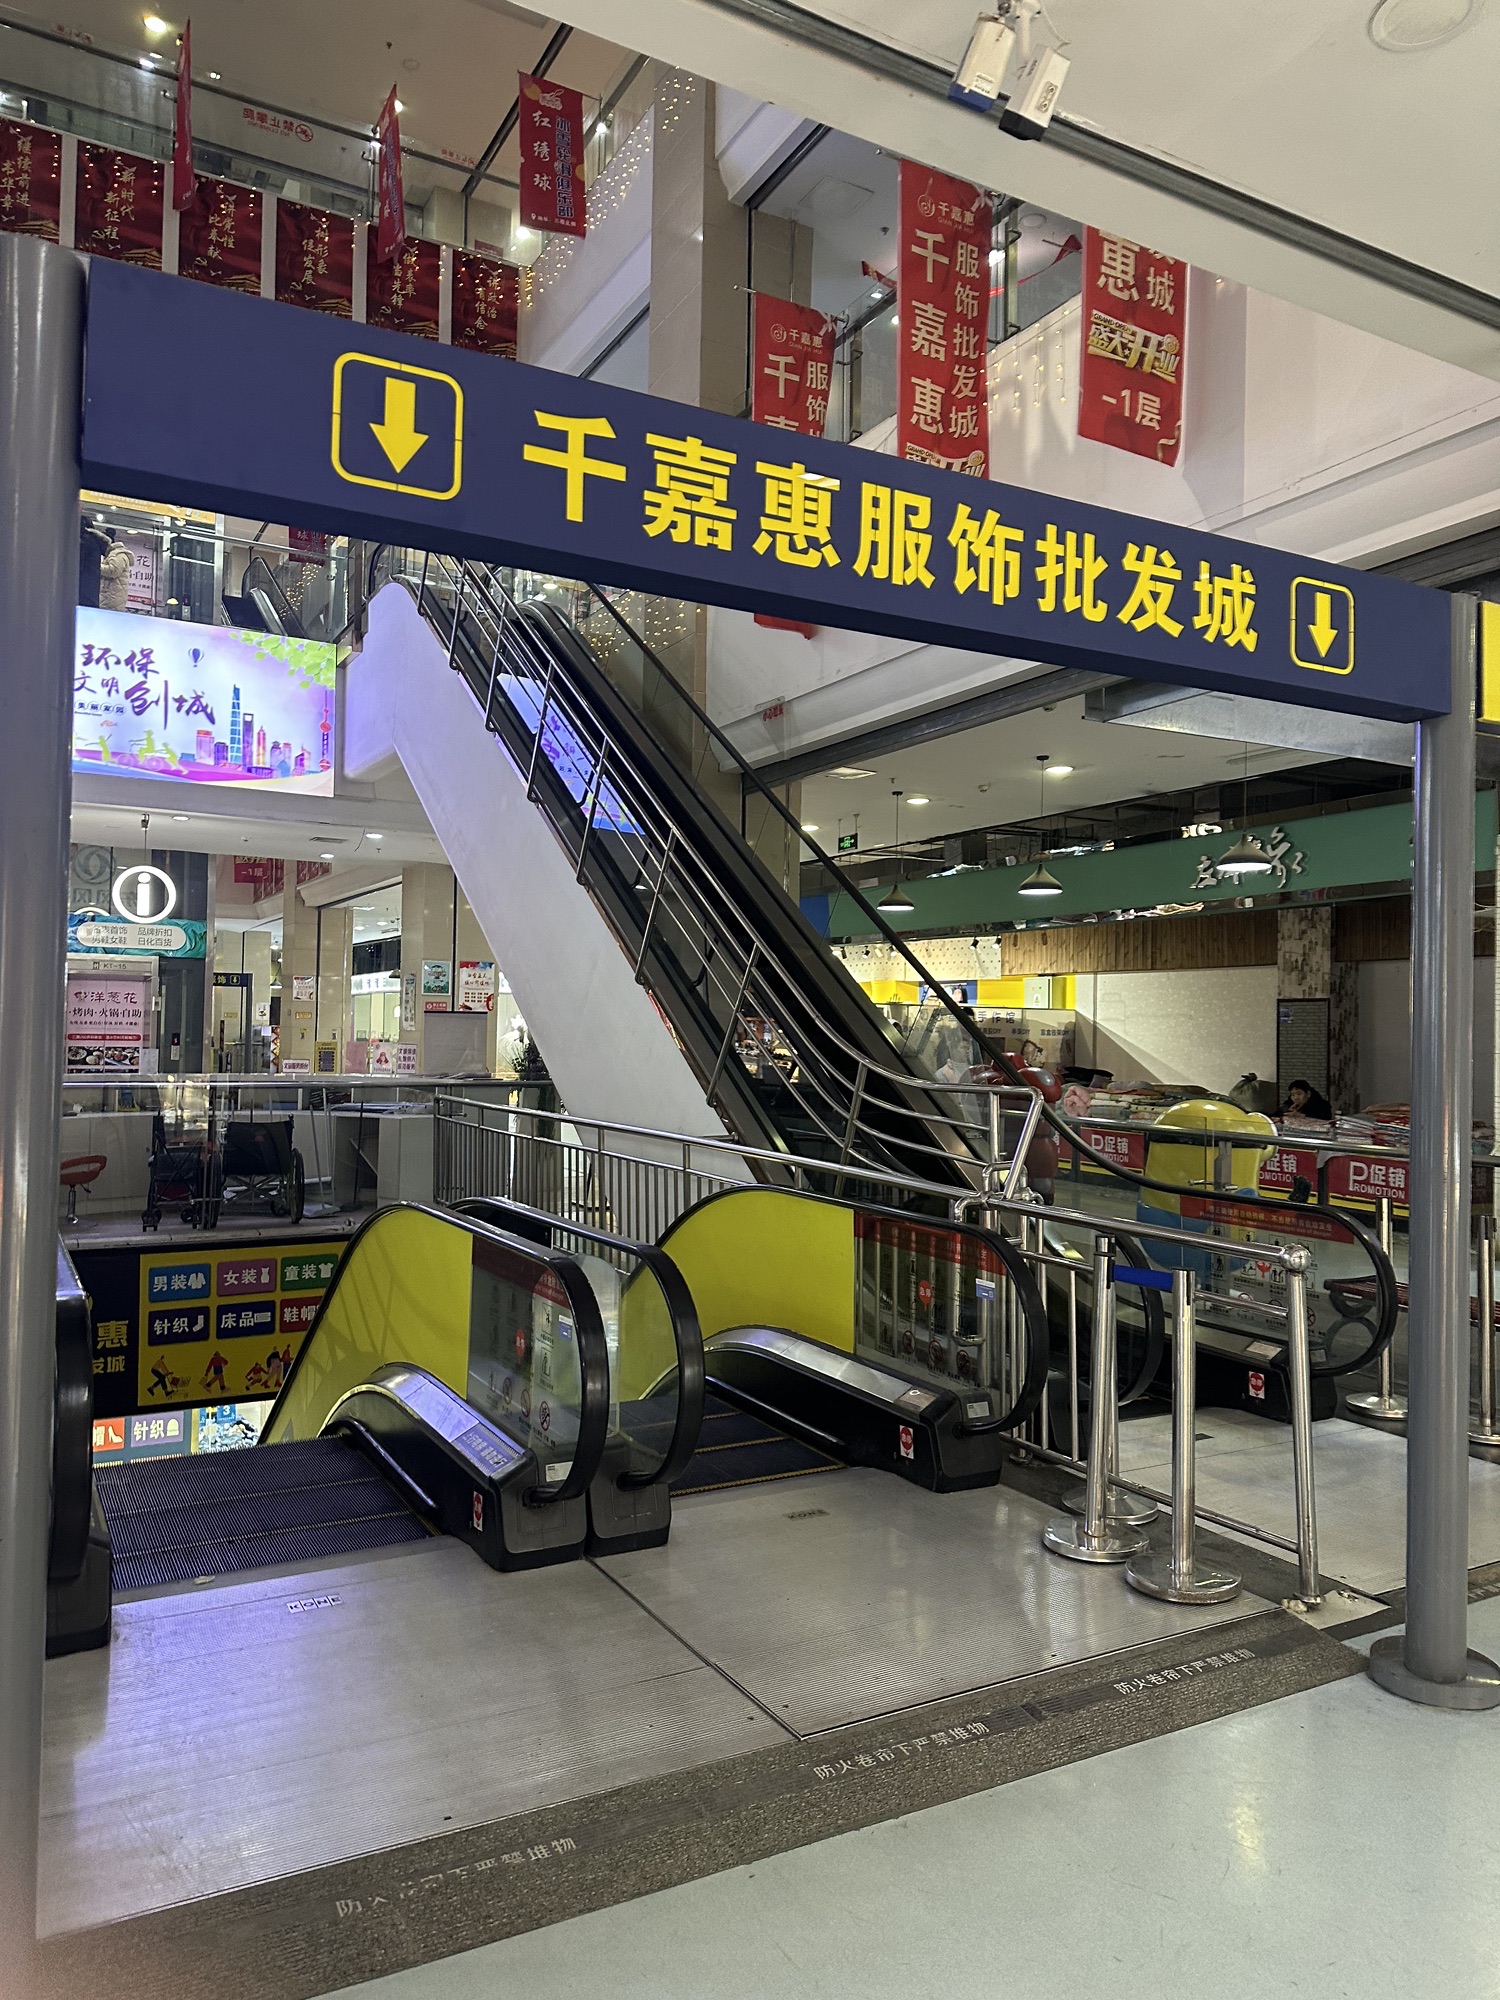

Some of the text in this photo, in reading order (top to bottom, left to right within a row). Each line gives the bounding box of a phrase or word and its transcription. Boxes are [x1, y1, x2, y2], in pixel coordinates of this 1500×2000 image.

[532, 109, 552, 191] 红绣球
[119, 168, 136, 221] 新时代
[103, 190, 121, 241] 新征程
[937, 200, 975, 227] 千嘉惠
[788, 328, 824, 349] 千嘉惠
[911, 228, 950, 435] 千嘉惠
[949, 239, 981, 439] 服饰批发城
[1088, 323, 1181, 379] 盛大开业
[805, 360, 829, 438] 服饰
[1101, 388, 1163, 432] -1层
[522, 409, 1260, 654] 千嘉惠服饰批发城
[80, 643, 160, 680] 环保
[124, 679, 216, 731] 创城
[137, 926, 173, 937] 品牌折扣
[152, 1273, 189, 1293] 男装
[223, 1268, 258, 1287] 女装
[284, 1263, 319, 1282] 童装
[153, 1316, 190, 1336] 针织
[220, 1312, 255, 1330] 床品
[283, 1305, 318, 1323] 鞋帽
[96, 1319, 129, 1350] 惠
[222, 1405, 231, 1416] 3
[133, 1419, 166, 1443] 针织
[288, 1595, 342, 1611] KONE
